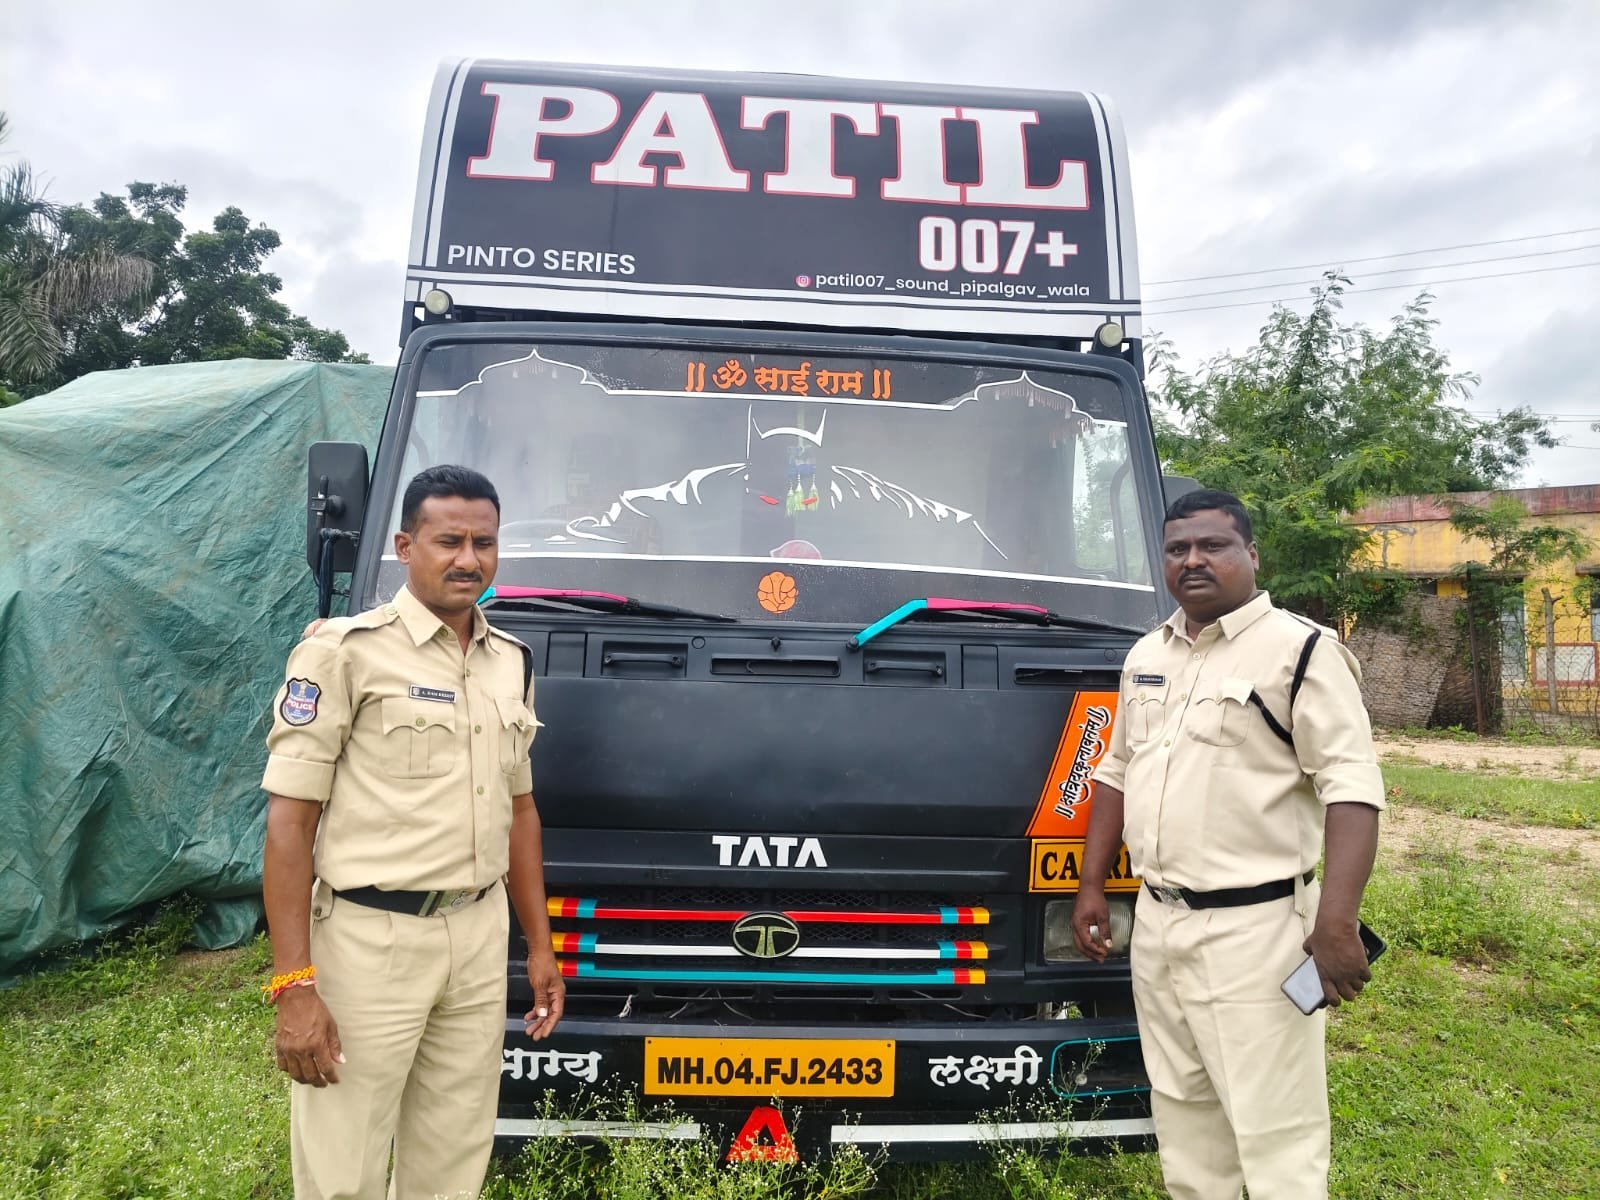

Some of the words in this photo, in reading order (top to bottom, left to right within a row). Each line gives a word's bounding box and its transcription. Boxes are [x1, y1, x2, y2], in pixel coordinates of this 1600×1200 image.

[466, 81, 1090, 210] PATIL
[447, 244, 536, 268] PINTO
[543, 248, 637, 275] SERIES
[919, 215, 1079, 276] 007+
[815, 273, 1090, 298] patil007_sound_pipalgav_wala
[712, 359, 748, 390] ॐ
[753, 361, 812, 396] साई
[815, 369, 863, 395] राम
[286, 699, 313, 711] POLICE
[712, 835, 828, 868] TATA
[657, 1056, 883, 1085] MH.04.FJ.2433
[928, 1044, 1044, 1091] लक्ष्मी
